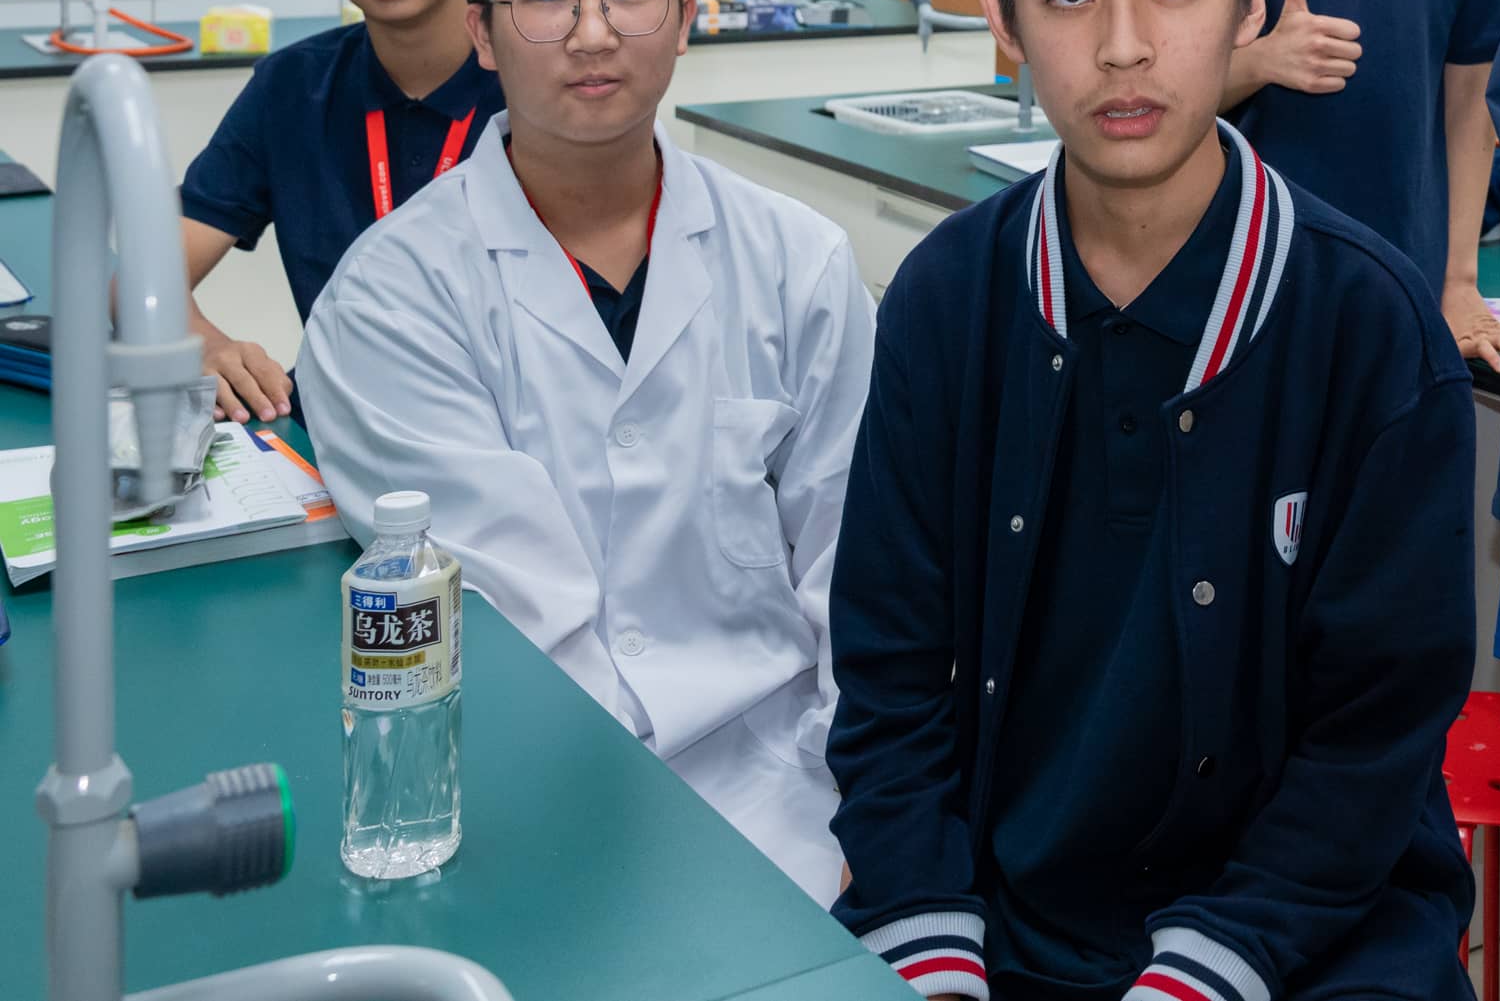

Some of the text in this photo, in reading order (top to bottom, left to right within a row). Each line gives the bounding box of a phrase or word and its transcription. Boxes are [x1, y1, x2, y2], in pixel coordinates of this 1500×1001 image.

[354, 595, 387, 609] 三得利
[354, 609, 434, 646] 乌龙茶
